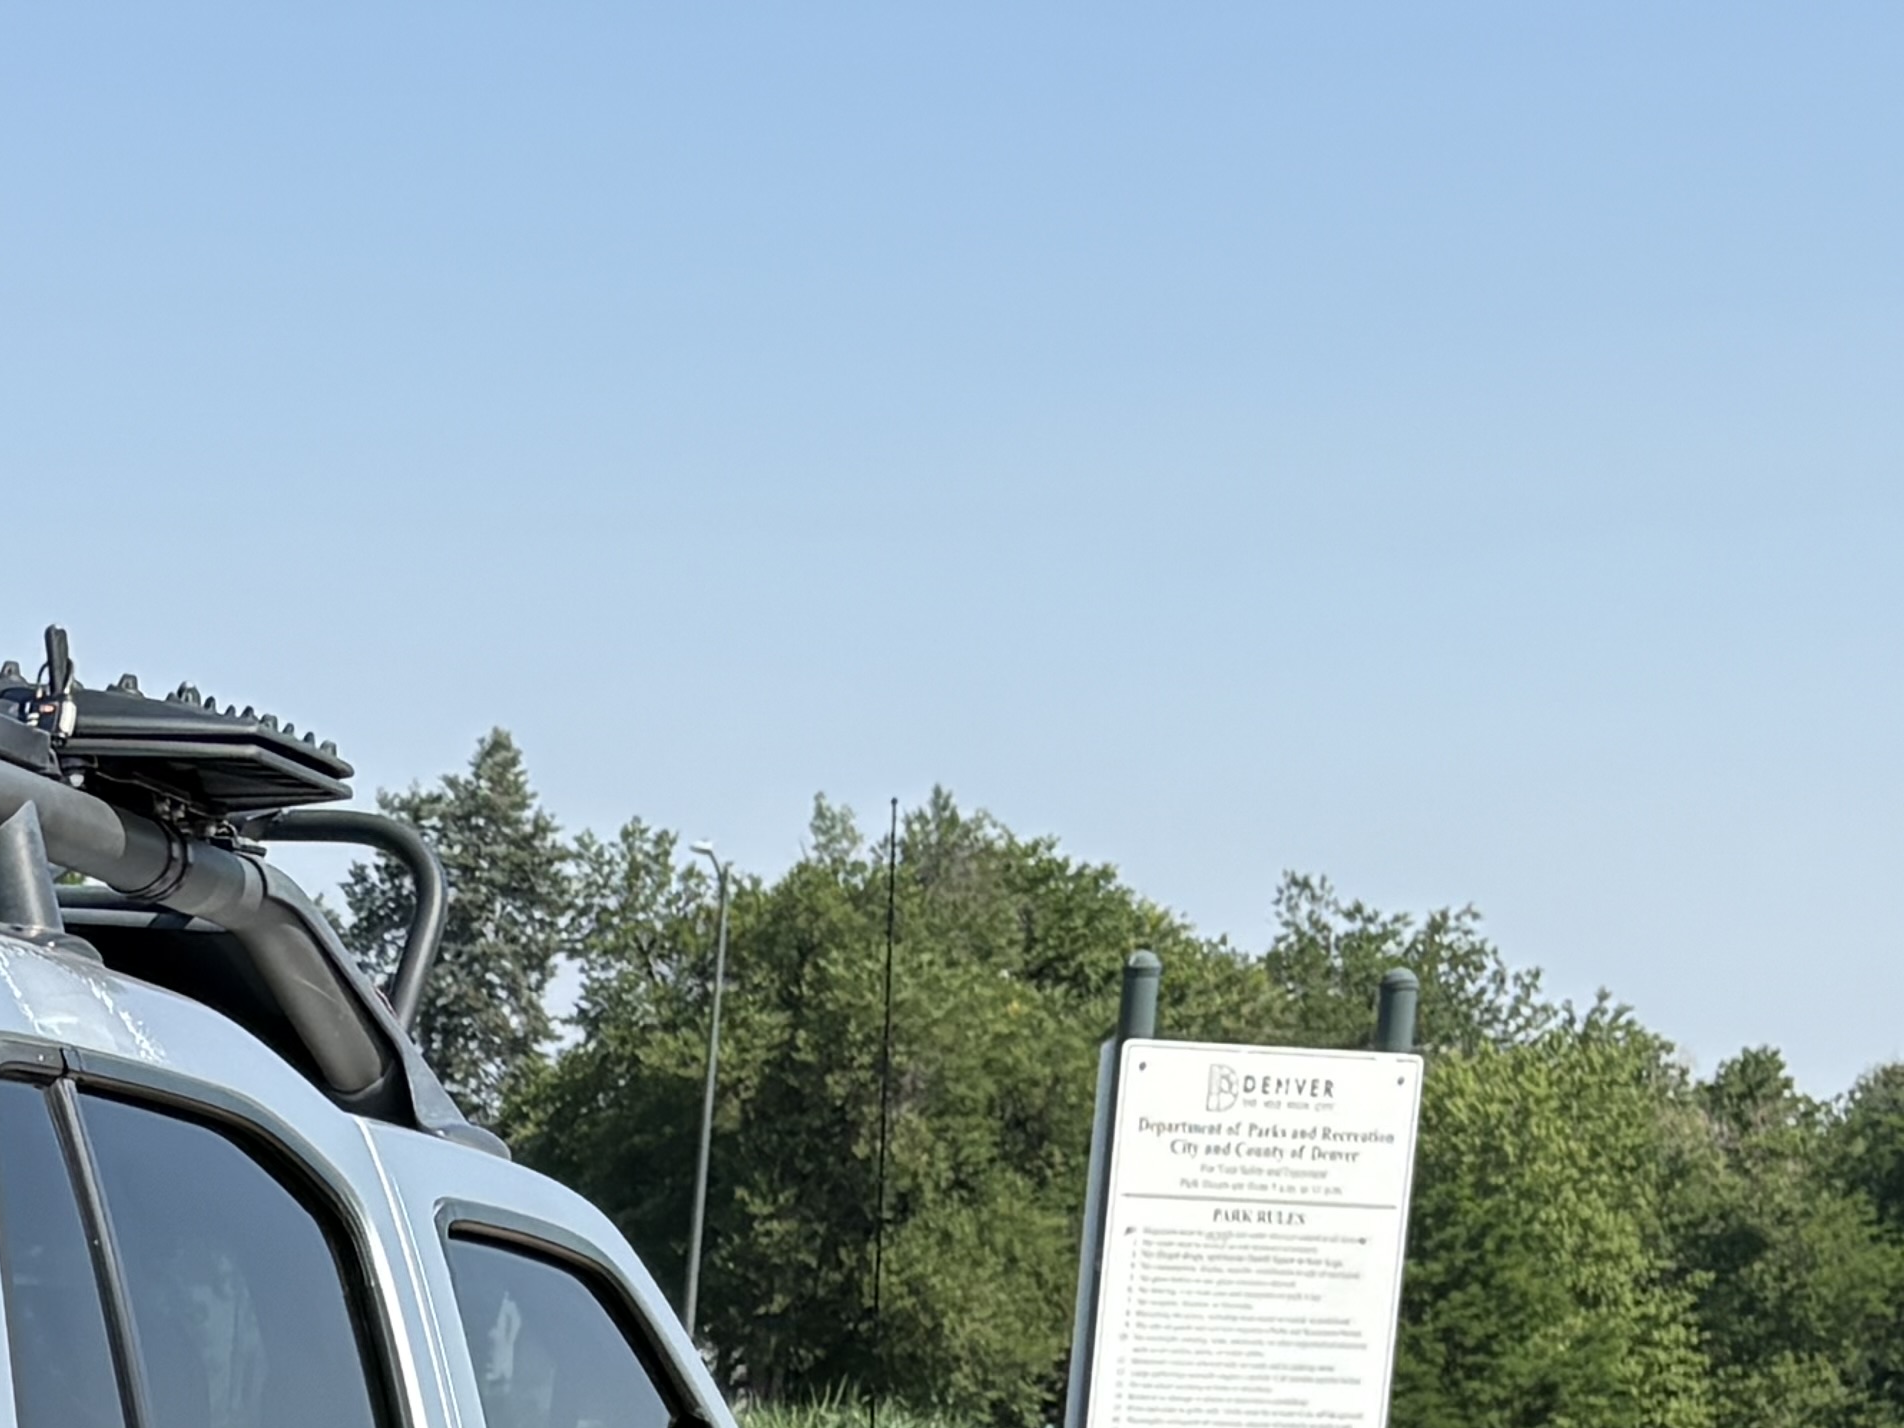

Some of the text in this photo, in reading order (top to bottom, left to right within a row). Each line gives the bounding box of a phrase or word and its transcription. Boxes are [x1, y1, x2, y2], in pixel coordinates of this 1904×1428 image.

[1242, 1074, 1335, 1099] DENVER
[1138, 1116, 1395, 1144] Department of Parks and Recreation
[1170, 1138, 1360, 1163] City and County of Denver
[1213, 1208, 1306, 1225] PARK RULES
